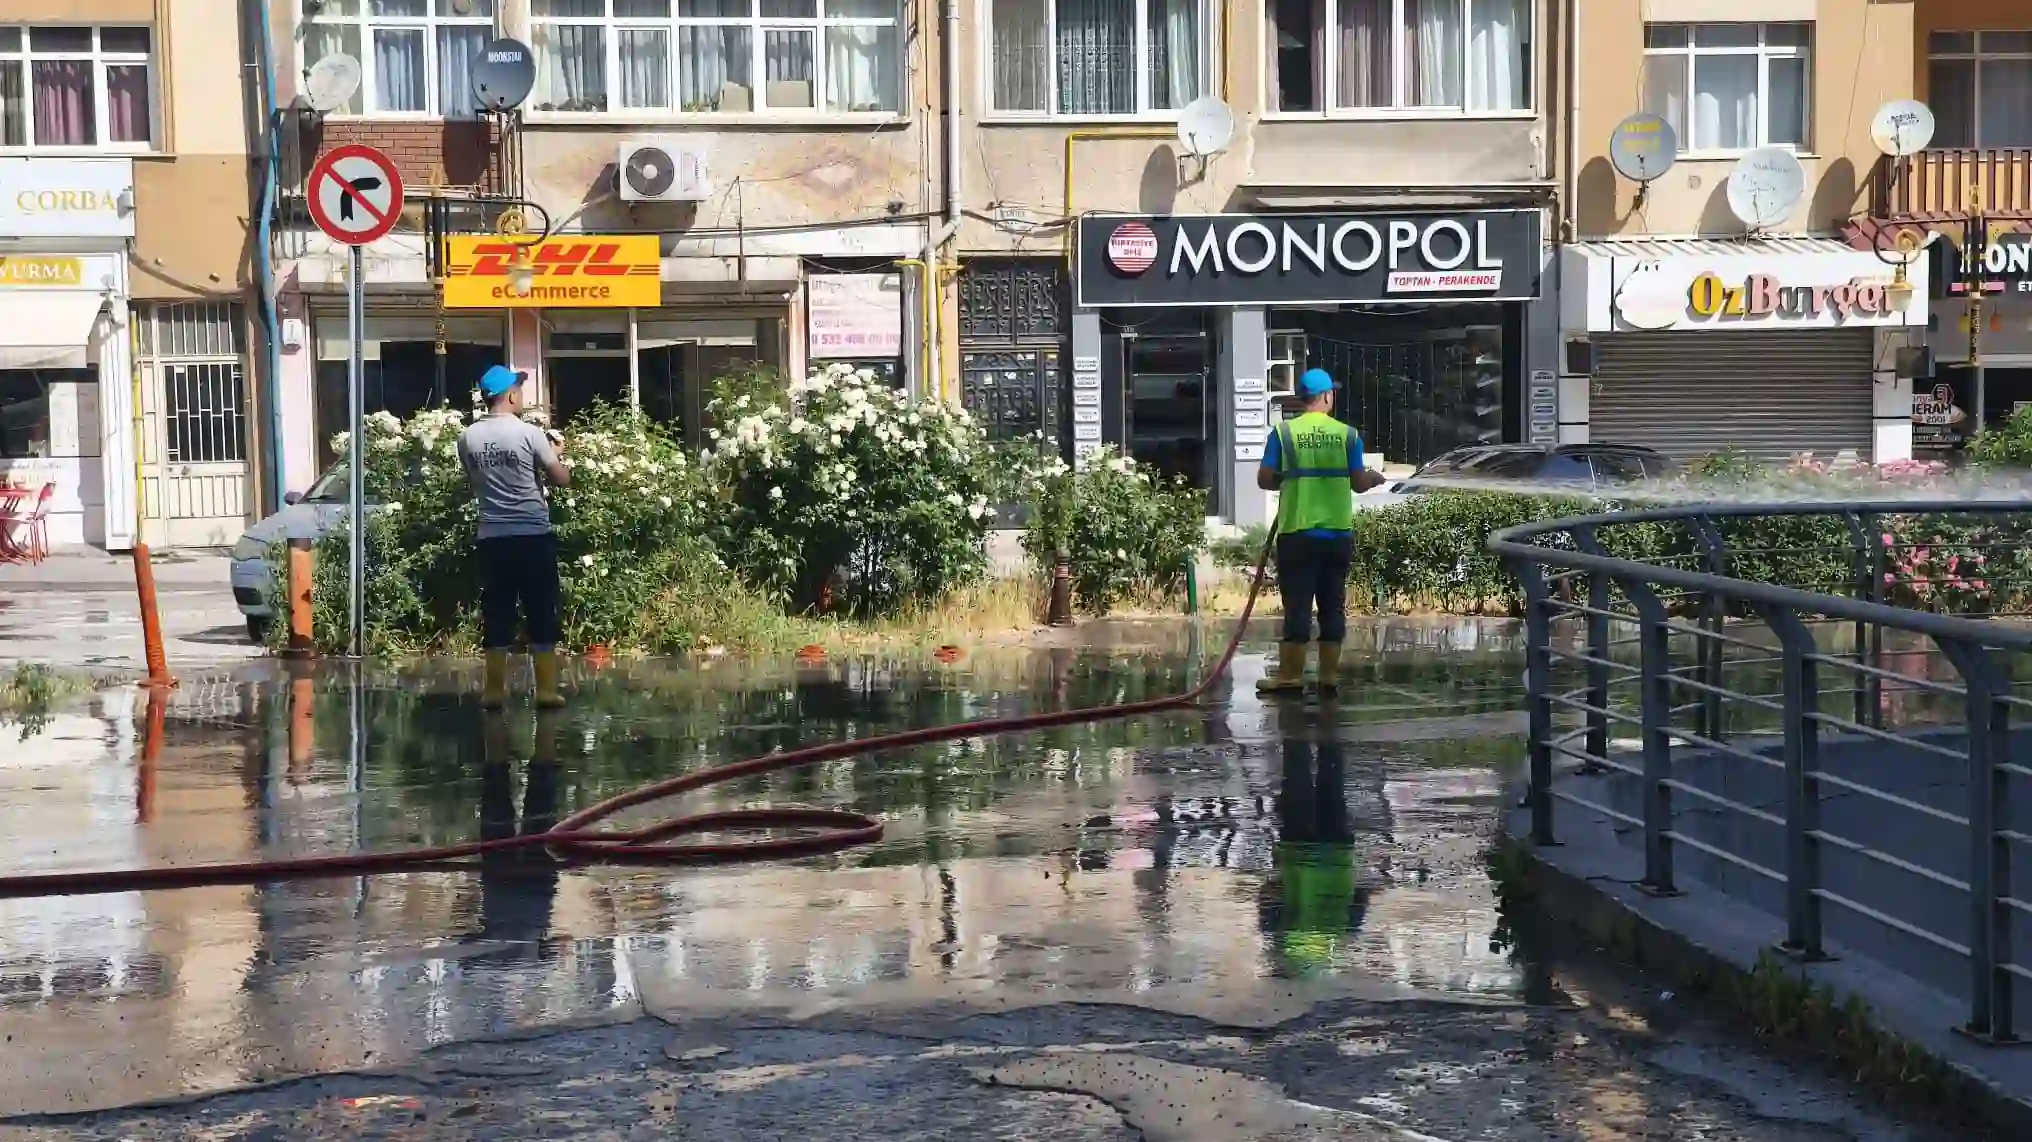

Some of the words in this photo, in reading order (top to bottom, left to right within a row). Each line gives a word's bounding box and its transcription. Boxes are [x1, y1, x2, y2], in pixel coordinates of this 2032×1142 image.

[470, 244, 631, 276] DHL
[1170, 219, 1503, 274] MONOPOL
[1394, 276, 1430, 286] TOPTAN
[1438, 275, 1496, 285] PERAKENDE
